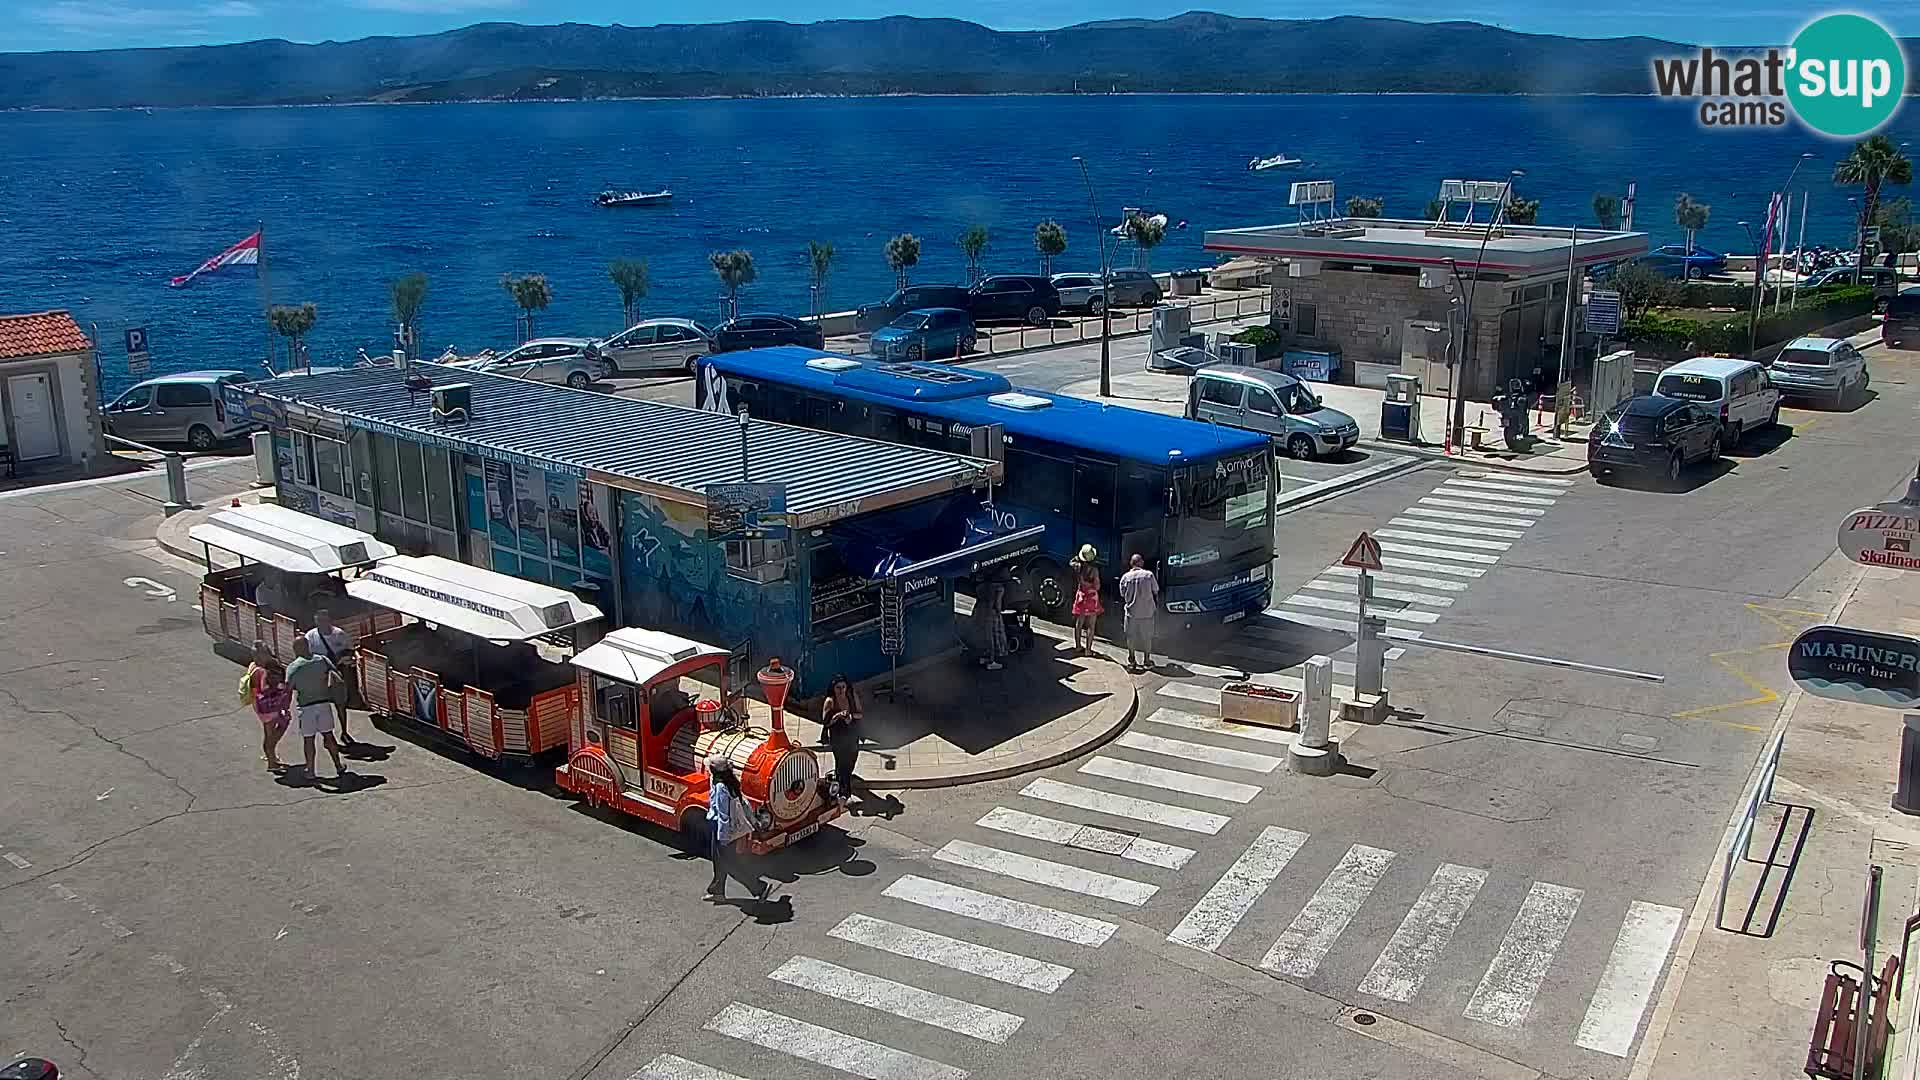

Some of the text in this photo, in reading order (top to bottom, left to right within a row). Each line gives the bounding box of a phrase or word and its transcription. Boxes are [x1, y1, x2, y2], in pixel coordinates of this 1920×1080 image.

[130, 331, 142, 349] P
[1682, 375, 1701, 385] TAXI
[477, 445, 493, 458] BUS
[494, 449, 527, 466] STATION
[527, 456, 554, 472] TICKET
[555, 463, 582, 478] OFFICE
[373, 573, 385, 584] BOL
[385, 576, 406, 590] CENTER
[409, 583, 430, 597] BEACH
[466, 599, 480, 611] BOL
[480, 603, 505, 619] CENTER
[1828, 662, 1897, 680] caffe bar
[649, 777, 675, 796] 1887
